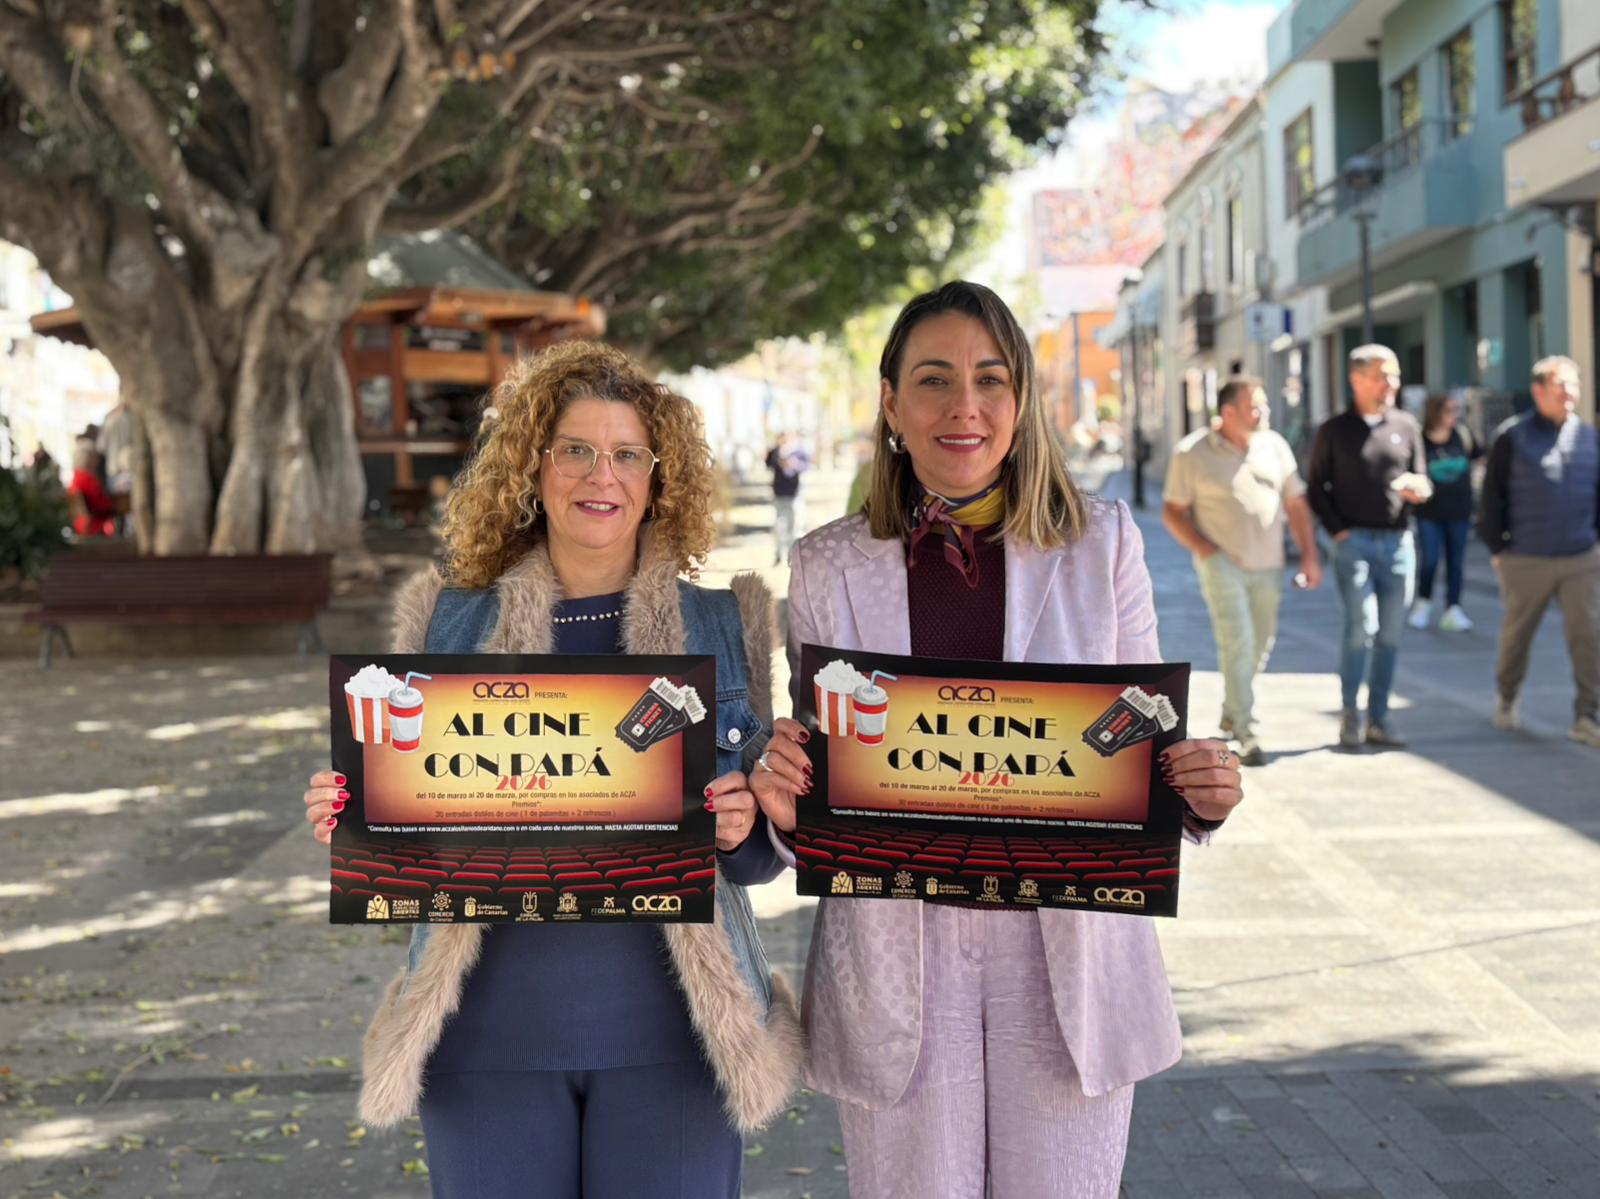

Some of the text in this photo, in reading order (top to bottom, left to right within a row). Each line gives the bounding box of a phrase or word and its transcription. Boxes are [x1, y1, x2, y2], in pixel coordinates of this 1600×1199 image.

[443, 712, 591, 736] AL CINE
[907, 712, 1057, 740] AL CINE
[424, 747, 611, 777] CON PAPÁ
[887, 747, 1076, 777] CON PAPÁ
[496, 775, 552, 790] 2026
[959, 771, 1015, 787] 2026
[486, 791, 494, 799] de
[495, 792, 518, 800] marzo,
[993, 788, 1020, 796] compras
